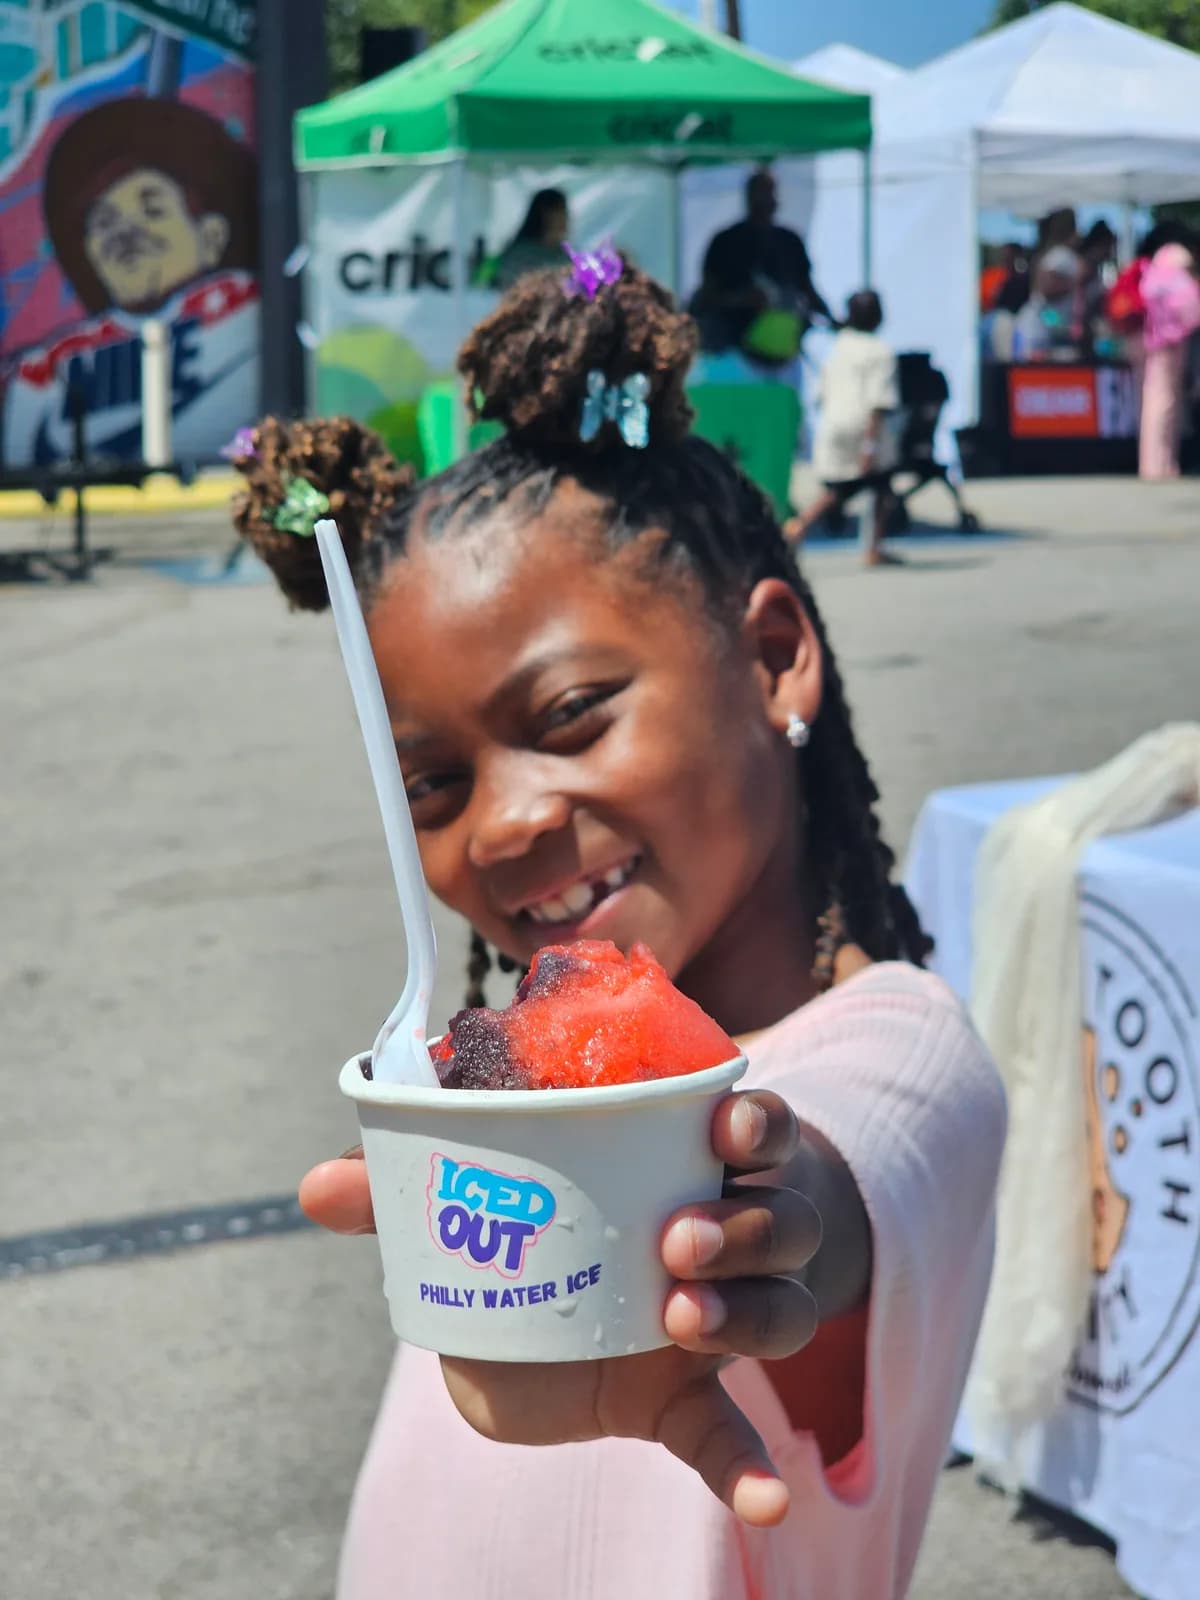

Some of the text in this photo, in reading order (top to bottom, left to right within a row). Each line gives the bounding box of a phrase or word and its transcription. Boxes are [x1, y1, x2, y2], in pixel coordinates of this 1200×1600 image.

[438, 1157, 556, 1226] ICED
[438, 1204, 536, 1271] OUT
[420, 1263, 602, 1309] PHILLY WATER ICE
